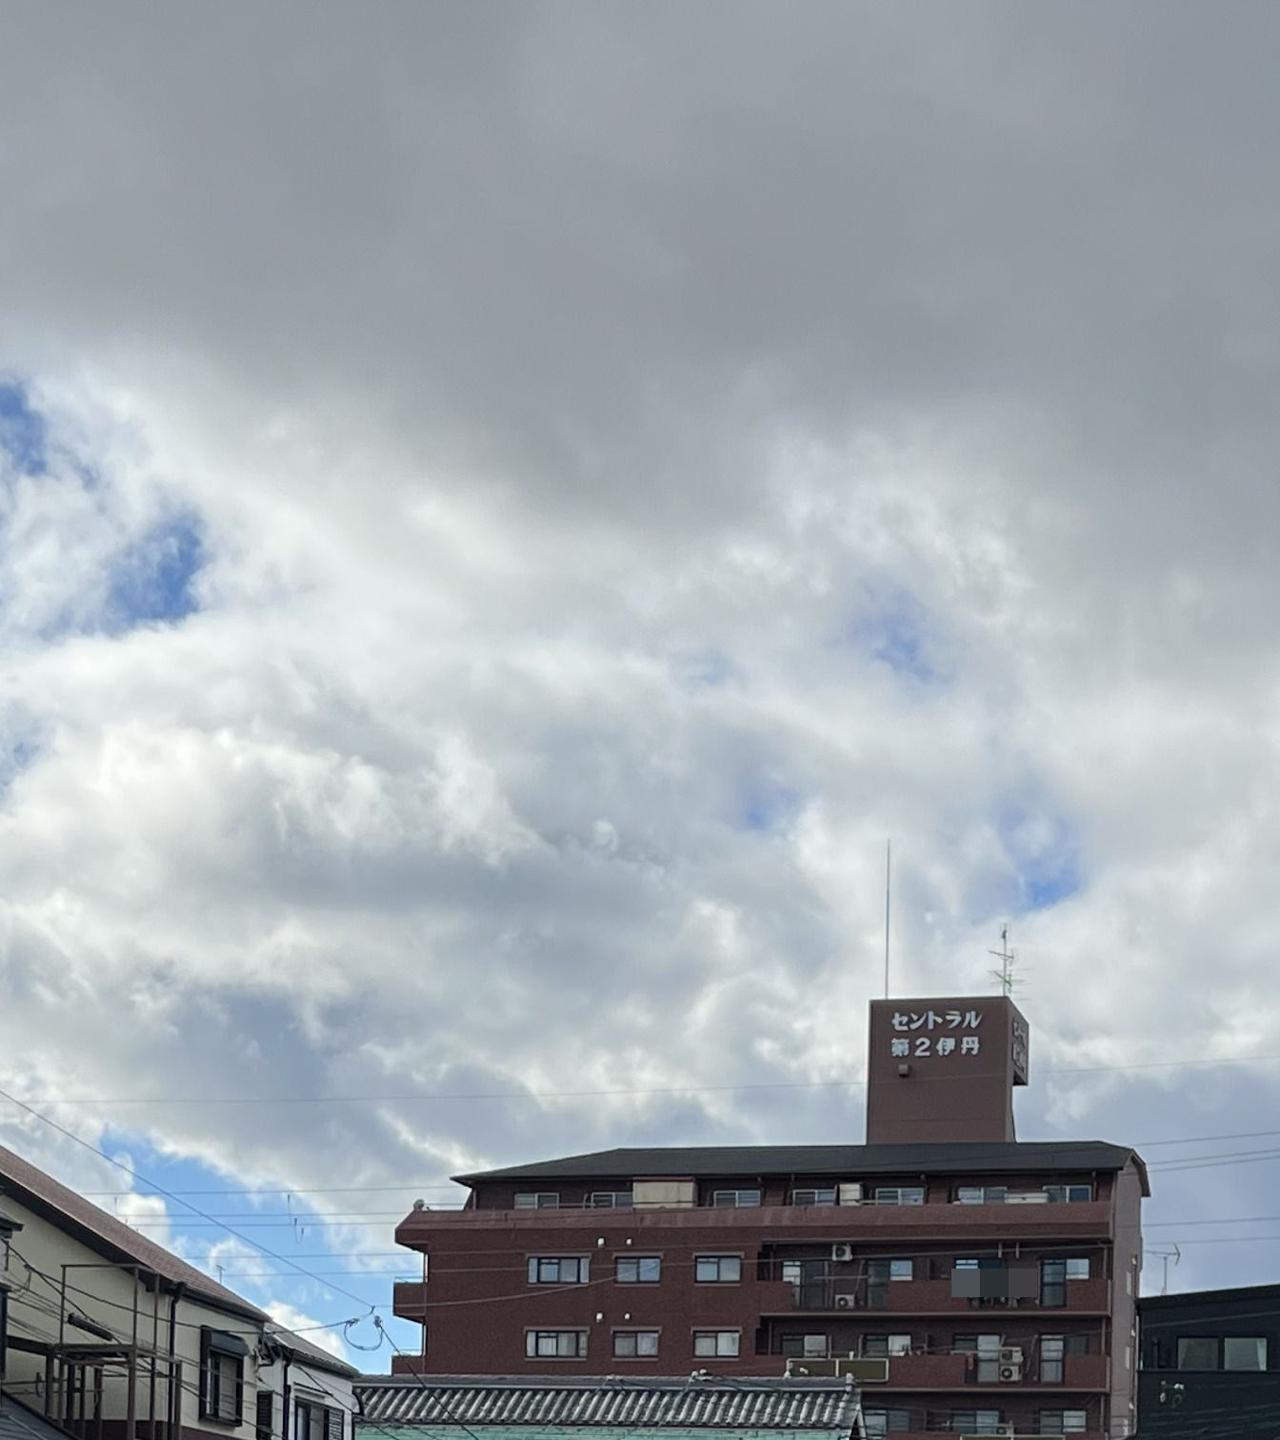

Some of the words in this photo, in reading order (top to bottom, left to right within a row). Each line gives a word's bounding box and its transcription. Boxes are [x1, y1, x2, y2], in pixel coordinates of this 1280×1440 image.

[891, 1010, 982, 1031] セントラル
[891, 1037, 980, 1057] 第2伊丹
